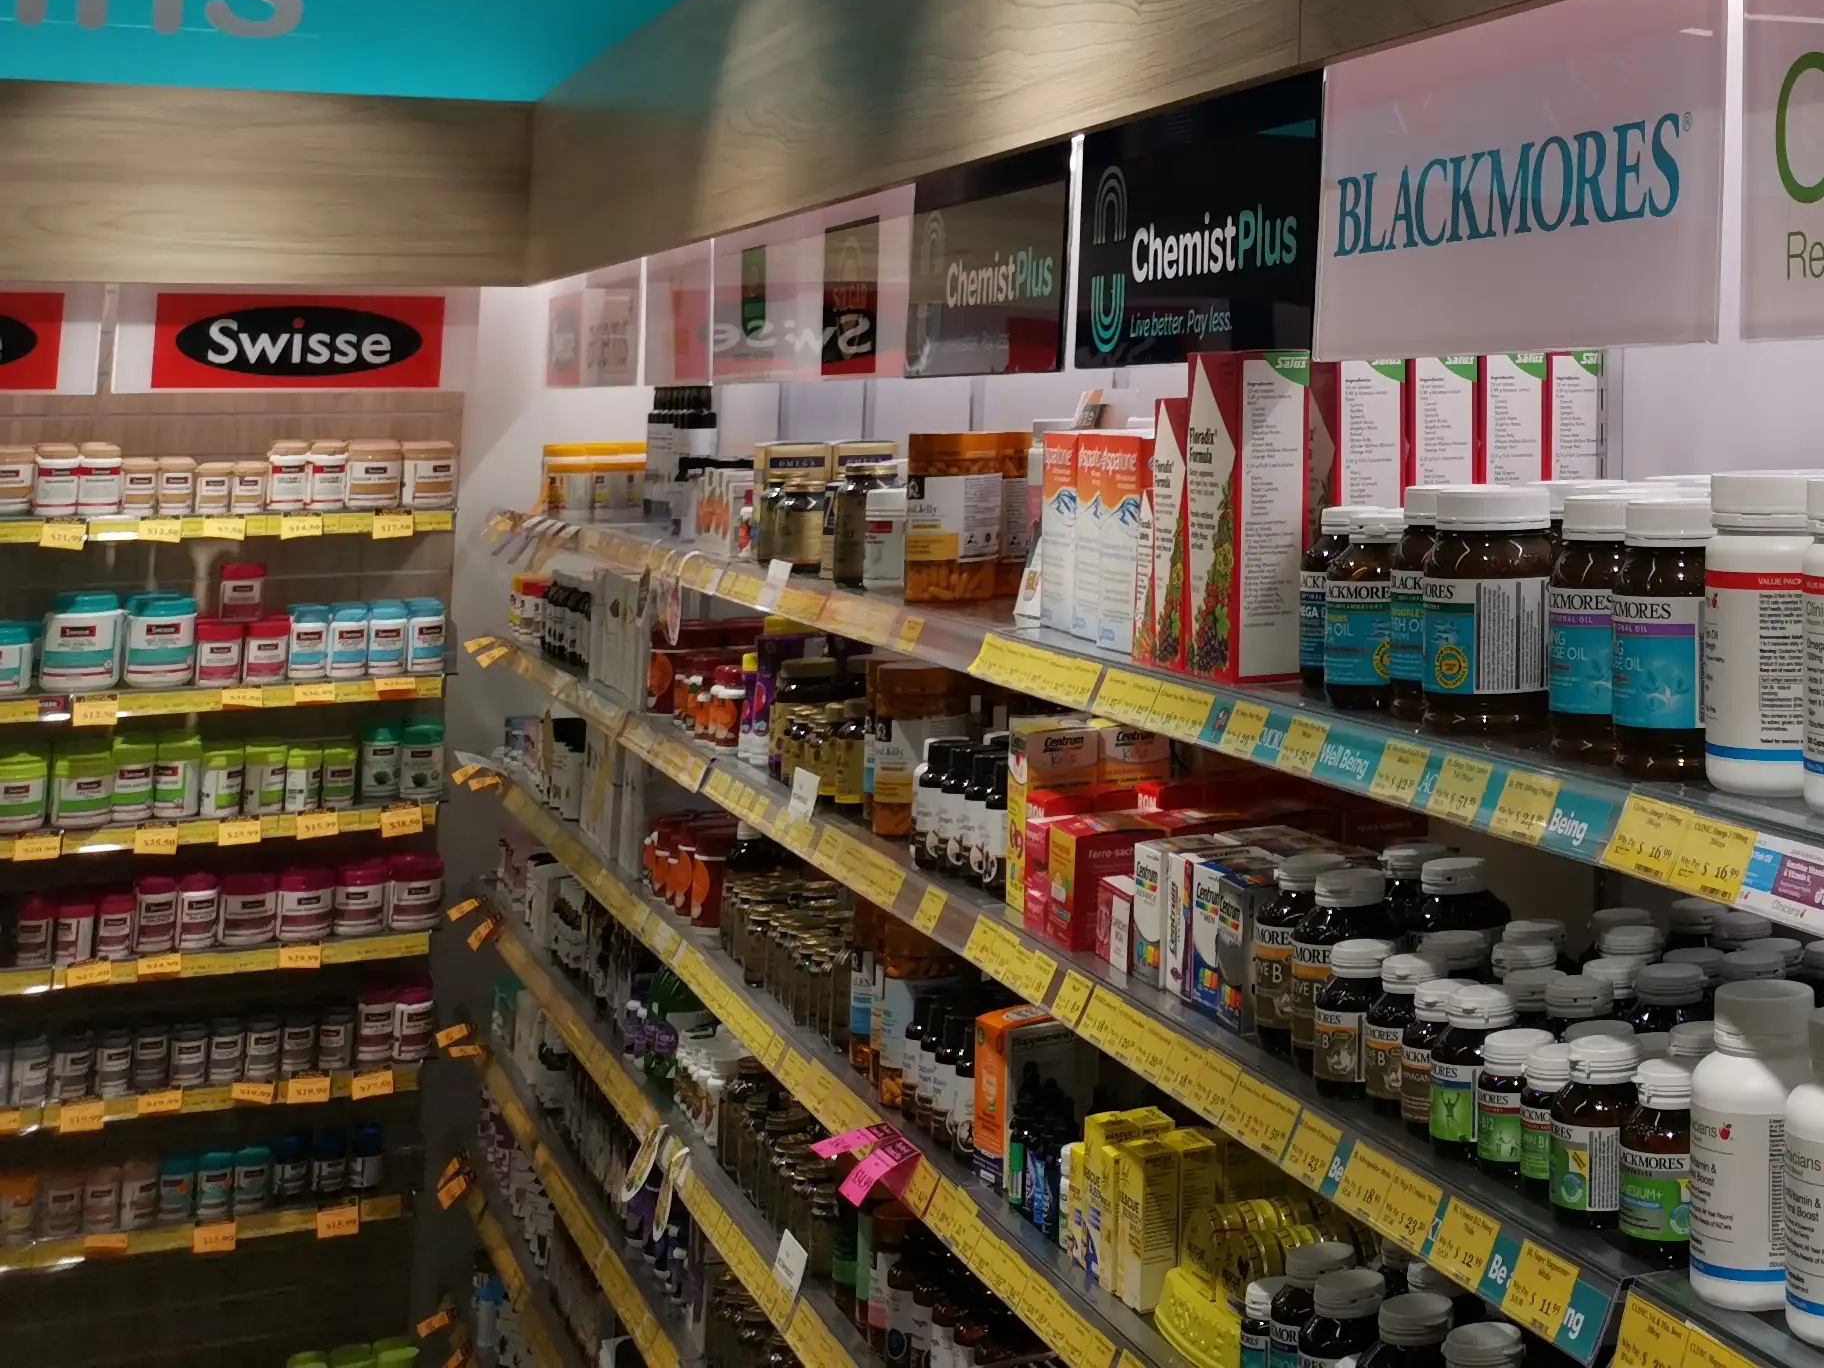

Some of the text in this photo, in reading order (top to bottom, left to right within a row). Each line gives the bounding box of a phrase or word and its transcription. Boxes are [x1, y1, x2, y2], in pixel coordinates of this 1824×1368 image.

[1334, 112, 1681, 257] BLACKMORES
[1131, 203, 1298, 283] ChemistPlus
[946, 246, 1053, 308] ChemistPlus
[1130, 305, 1232, 340] Live better. Pay less.
[207, 317, 391, 365] Swisse
[1275, 356, 1308, 369] Salus
[1515, 352, 1544, 364] Salus
[778, 459, 816, 468] OMEGA
[1189, 447, 1212, 465] Formula
[1567, 647, 1587, 661] OIL
[1044, 736, 1084, 748] Centrum
[1115, 731, 1156, 743] Centrum
[1319, 742, 1370, 781] Well Being
[1548, 807, 1588, 846] Being
[1136, 861, 1158, 884] Centrum
[1196, 882, 1220, 905] Centrum
[1814, 1198, 1821, 1208] &
[1797, 1208, 1819, 1222] Boost
